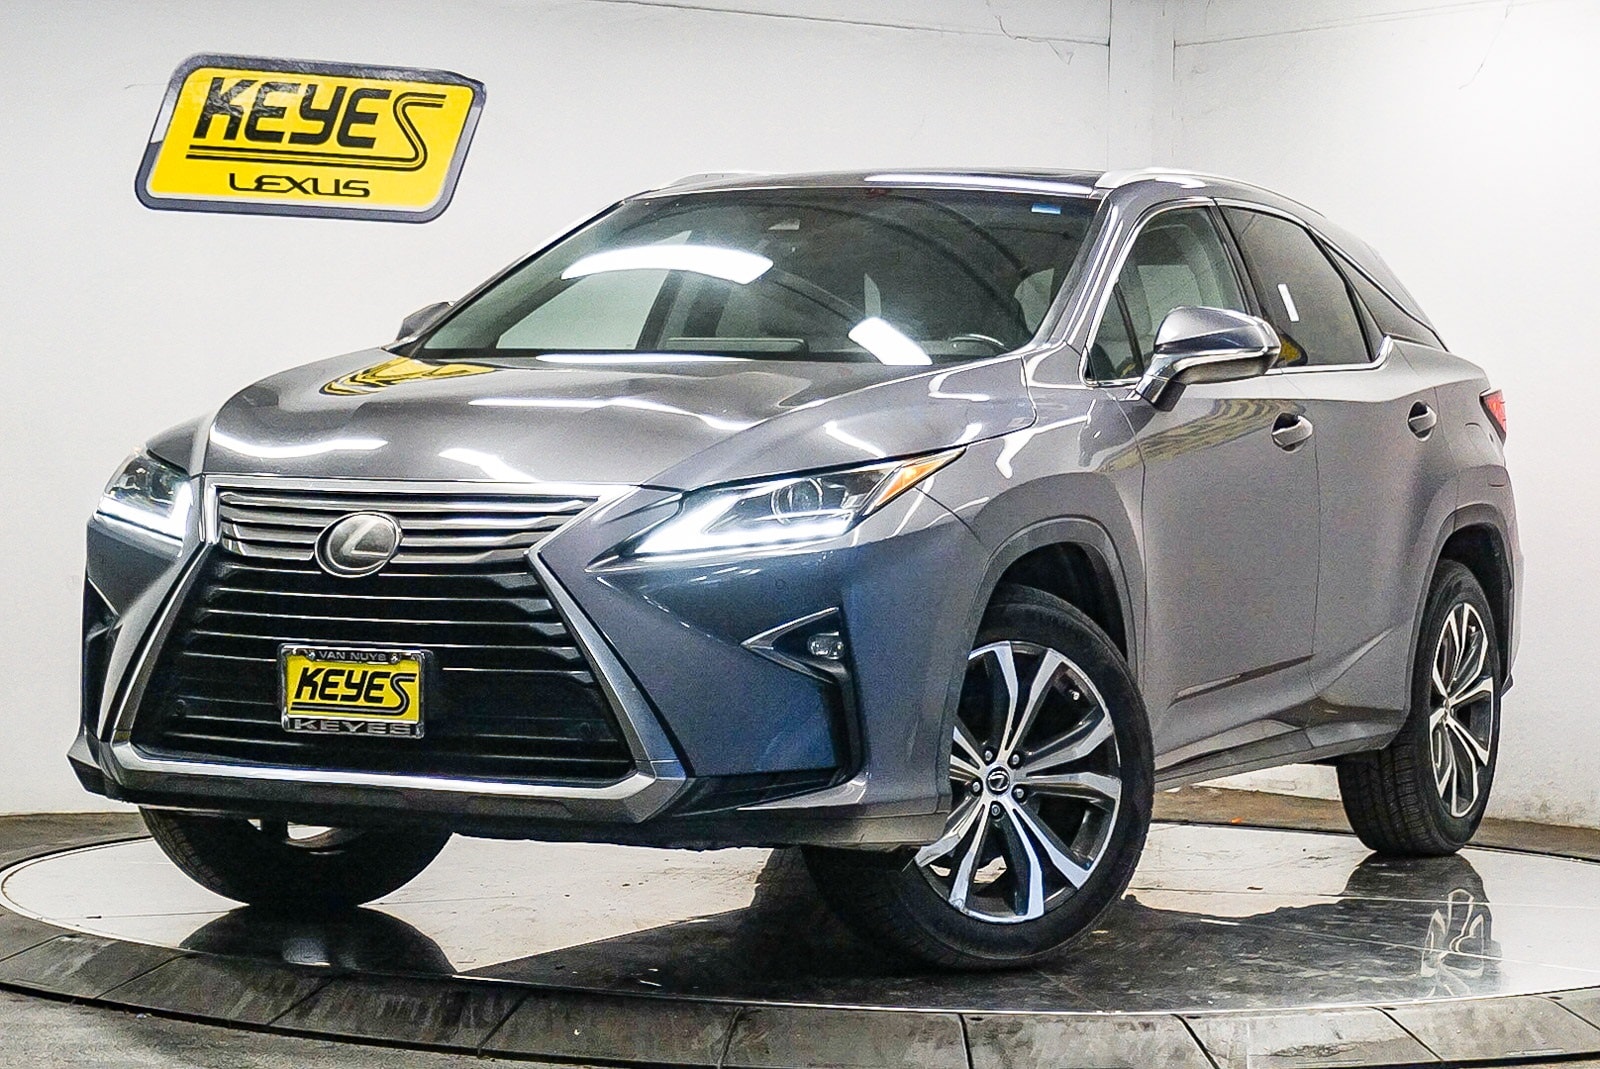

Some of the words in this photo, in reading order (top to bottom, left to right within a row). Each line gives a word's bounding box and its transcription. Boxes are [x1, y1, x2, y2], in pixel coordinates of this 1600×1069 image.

[186, 77, 447, 172] KEYES
[229, 173, 370, 198] LEXUS
[319, 650, 346, 661] VAN
[349, 651, 387, 662] NUYS
[291, 667, 417, 716] KEYES
[294, 719, 411, 735] KEYES
